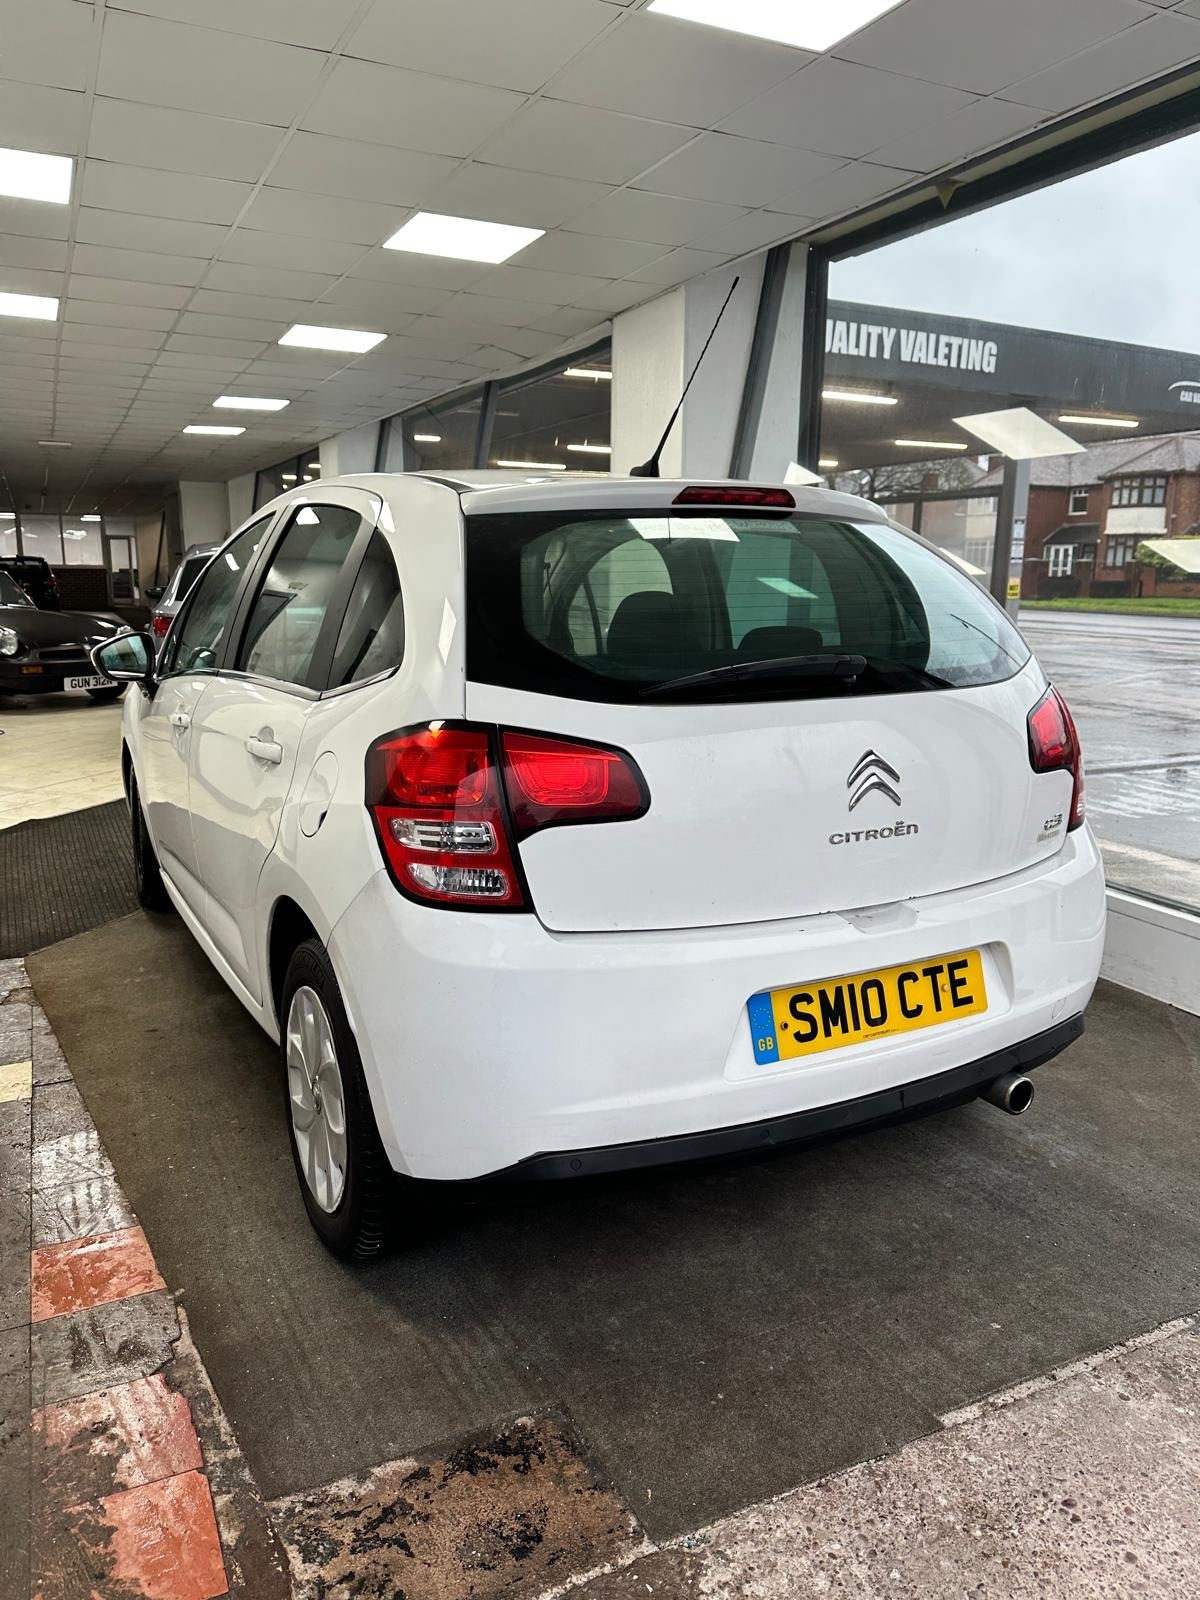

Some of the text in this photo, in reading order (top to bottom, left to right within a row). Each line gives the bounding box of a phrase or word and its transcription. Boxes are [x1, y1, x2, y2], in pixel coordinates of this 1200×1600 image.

[825, 319, 998, 373] ALITY VALETING
[71, 677, 90, 689] GUN
[789, 958, 974, 1043] SM10 CTE
[758, 1037, 774, 1052] GB
